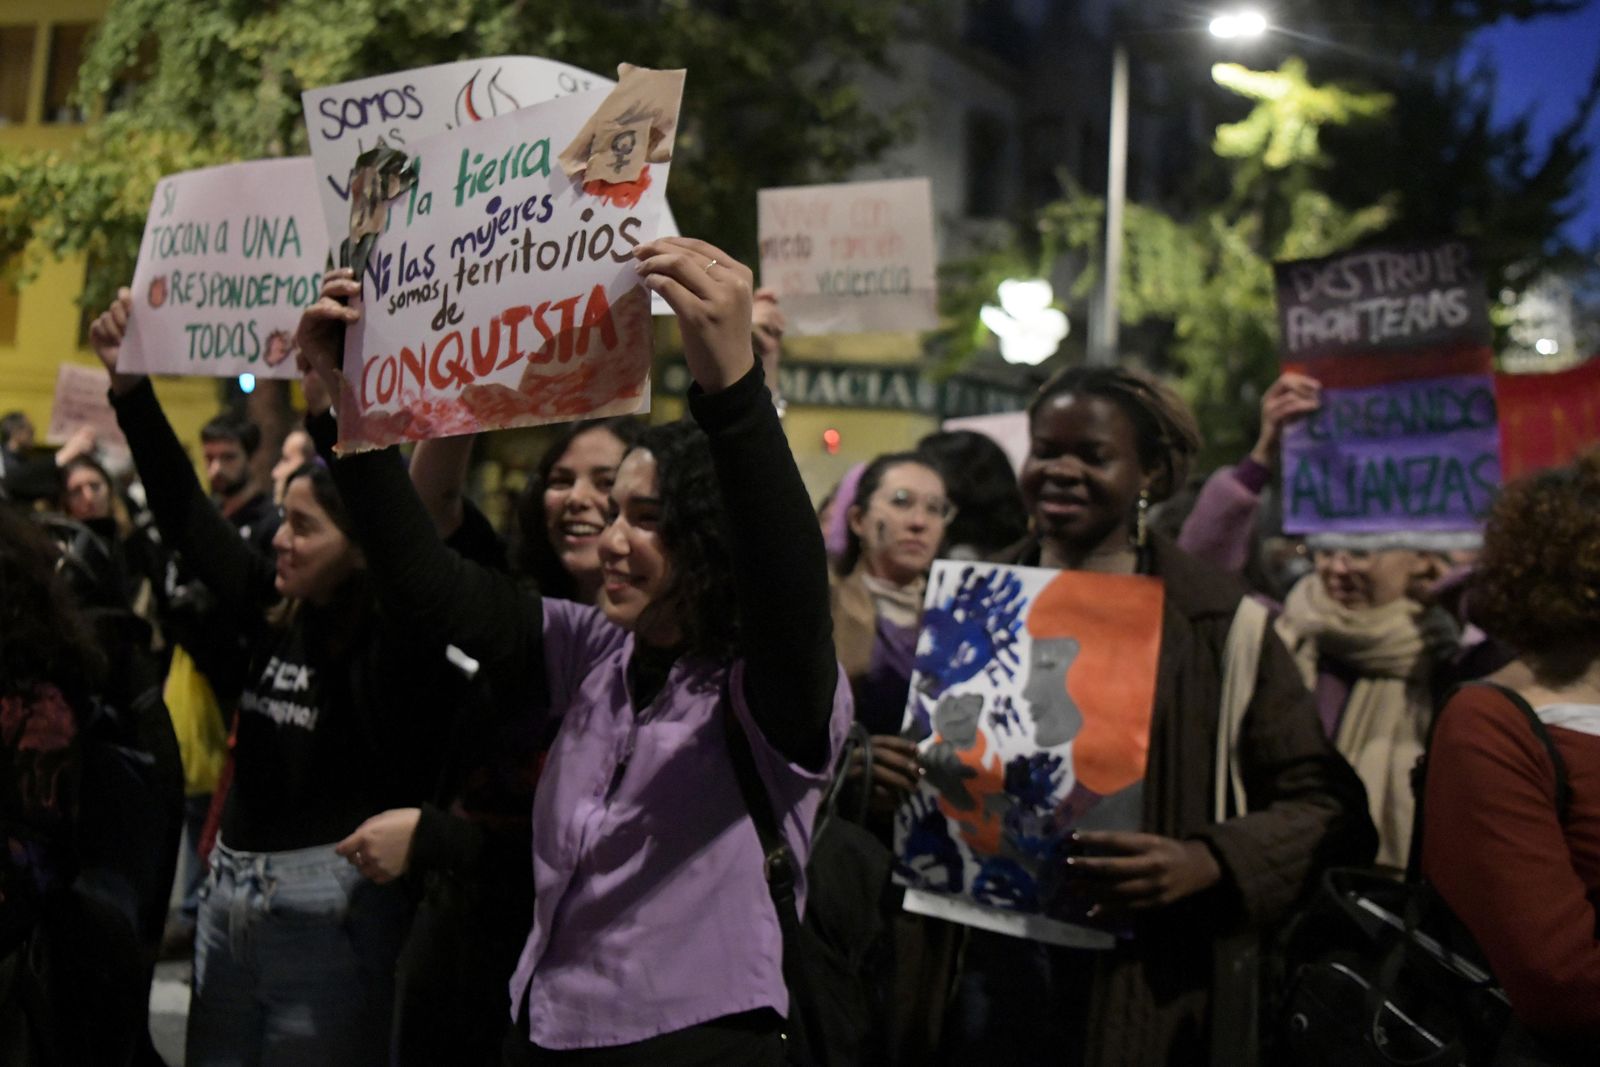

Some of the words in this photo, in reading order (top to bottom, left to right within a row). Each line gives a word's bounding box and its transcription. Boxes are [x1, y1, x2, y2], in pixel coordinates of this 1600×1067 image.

[454, 136, 551, 207] tierra
[242, 214, 303, 260] UNA
[397, 240, 437, 286] las
[450, 193, 553, 258] mujeres
[170, 270, 322, 308] RESPONDEMOS
[387, 279, 441, 315] somos
[1293, 243, 1470, 301] DESTRUIR
[431, 283, 464, 331] de
[361, 284, 619, 408] CONQUISTA
[1290, 453, 1500, 519] ALIANZAS
